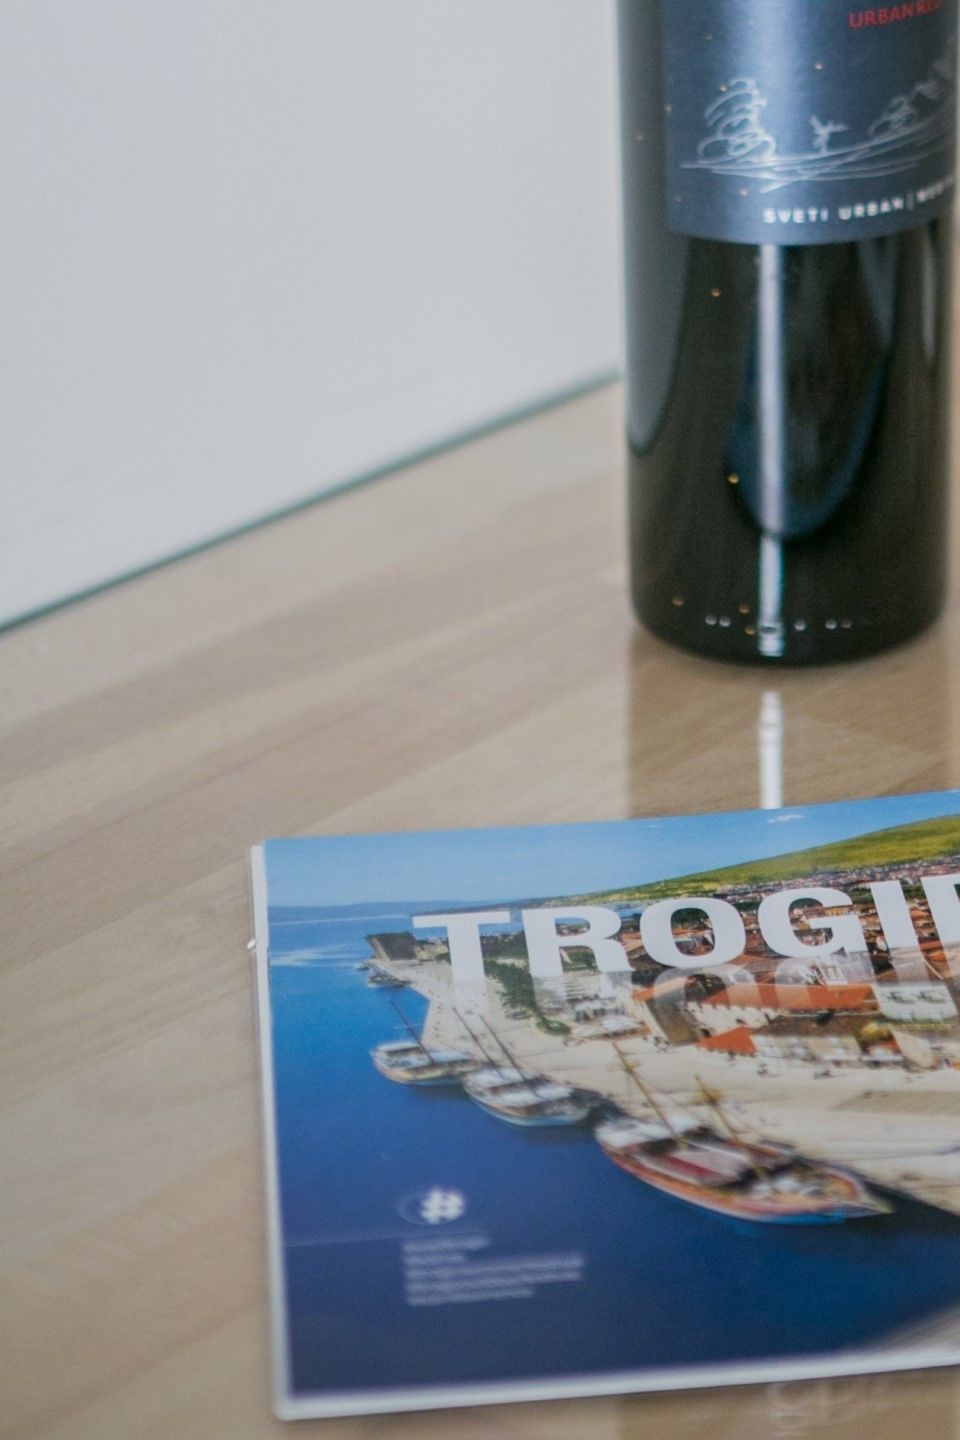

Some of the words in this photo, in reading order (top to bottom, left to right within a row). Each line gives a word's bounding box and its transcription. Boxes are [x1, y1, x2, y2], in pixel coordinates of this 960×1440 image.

[848, 3, 914, 31] URBAN
[762, 207, 829, 224] SVETI
[838, 196, 904, 221] URBAN
